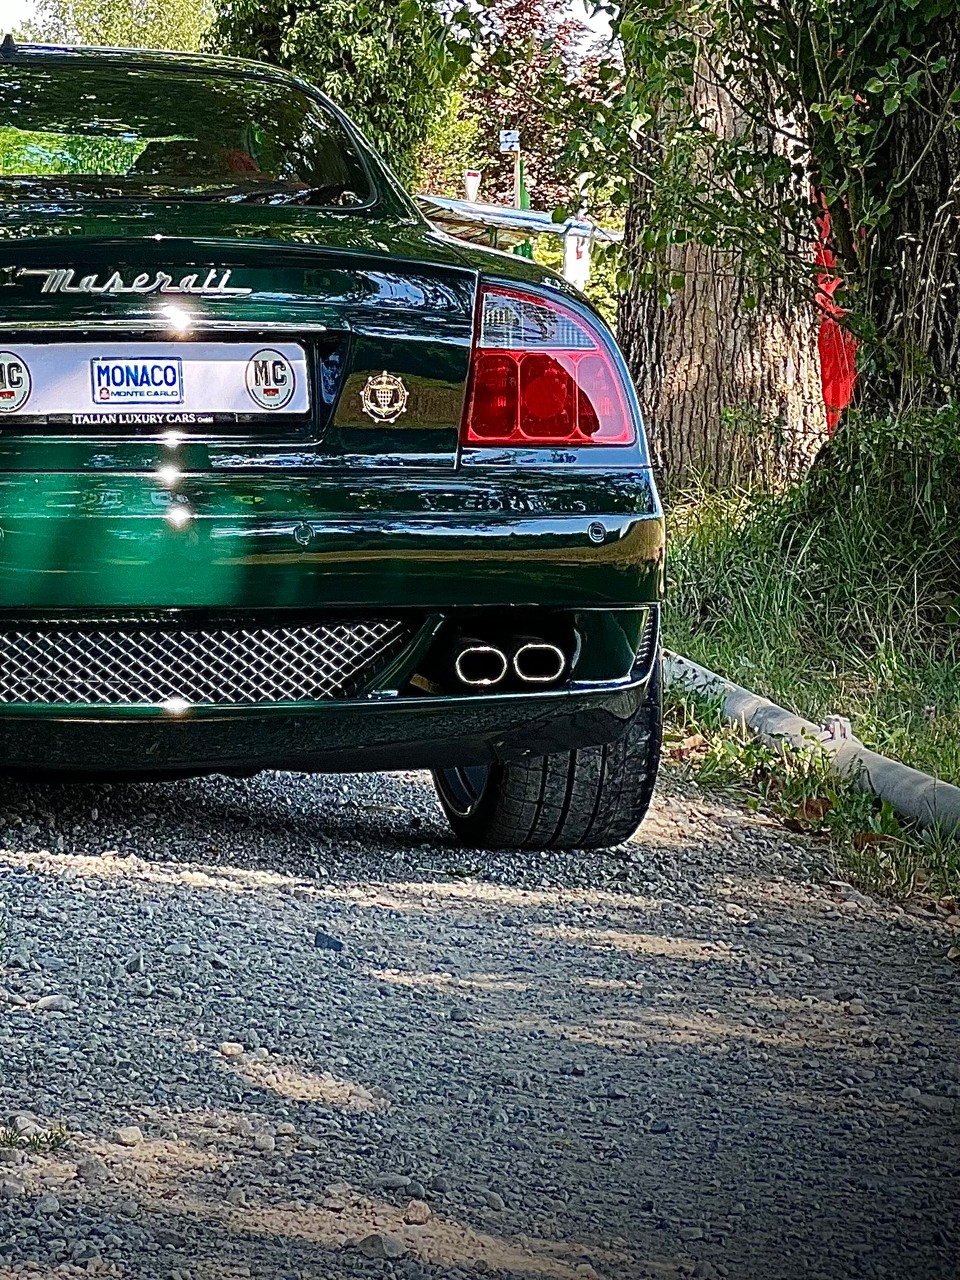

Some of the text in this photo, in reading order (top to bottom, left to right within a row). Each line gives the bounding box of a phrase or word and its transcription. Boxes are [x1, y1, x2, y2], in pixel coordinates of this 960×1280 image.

[18, 268, 253, 294] Maserati
[96, 364, 177, 387] MONACO
[253, 360, 288, 387] MC
[110, 389, 179, 397] MONTE CARLO
[72, 413, 117, 425] ITALIAN
[118, 413, 166, 425] LUXURY
[166, 413, 197, 424] CARS
